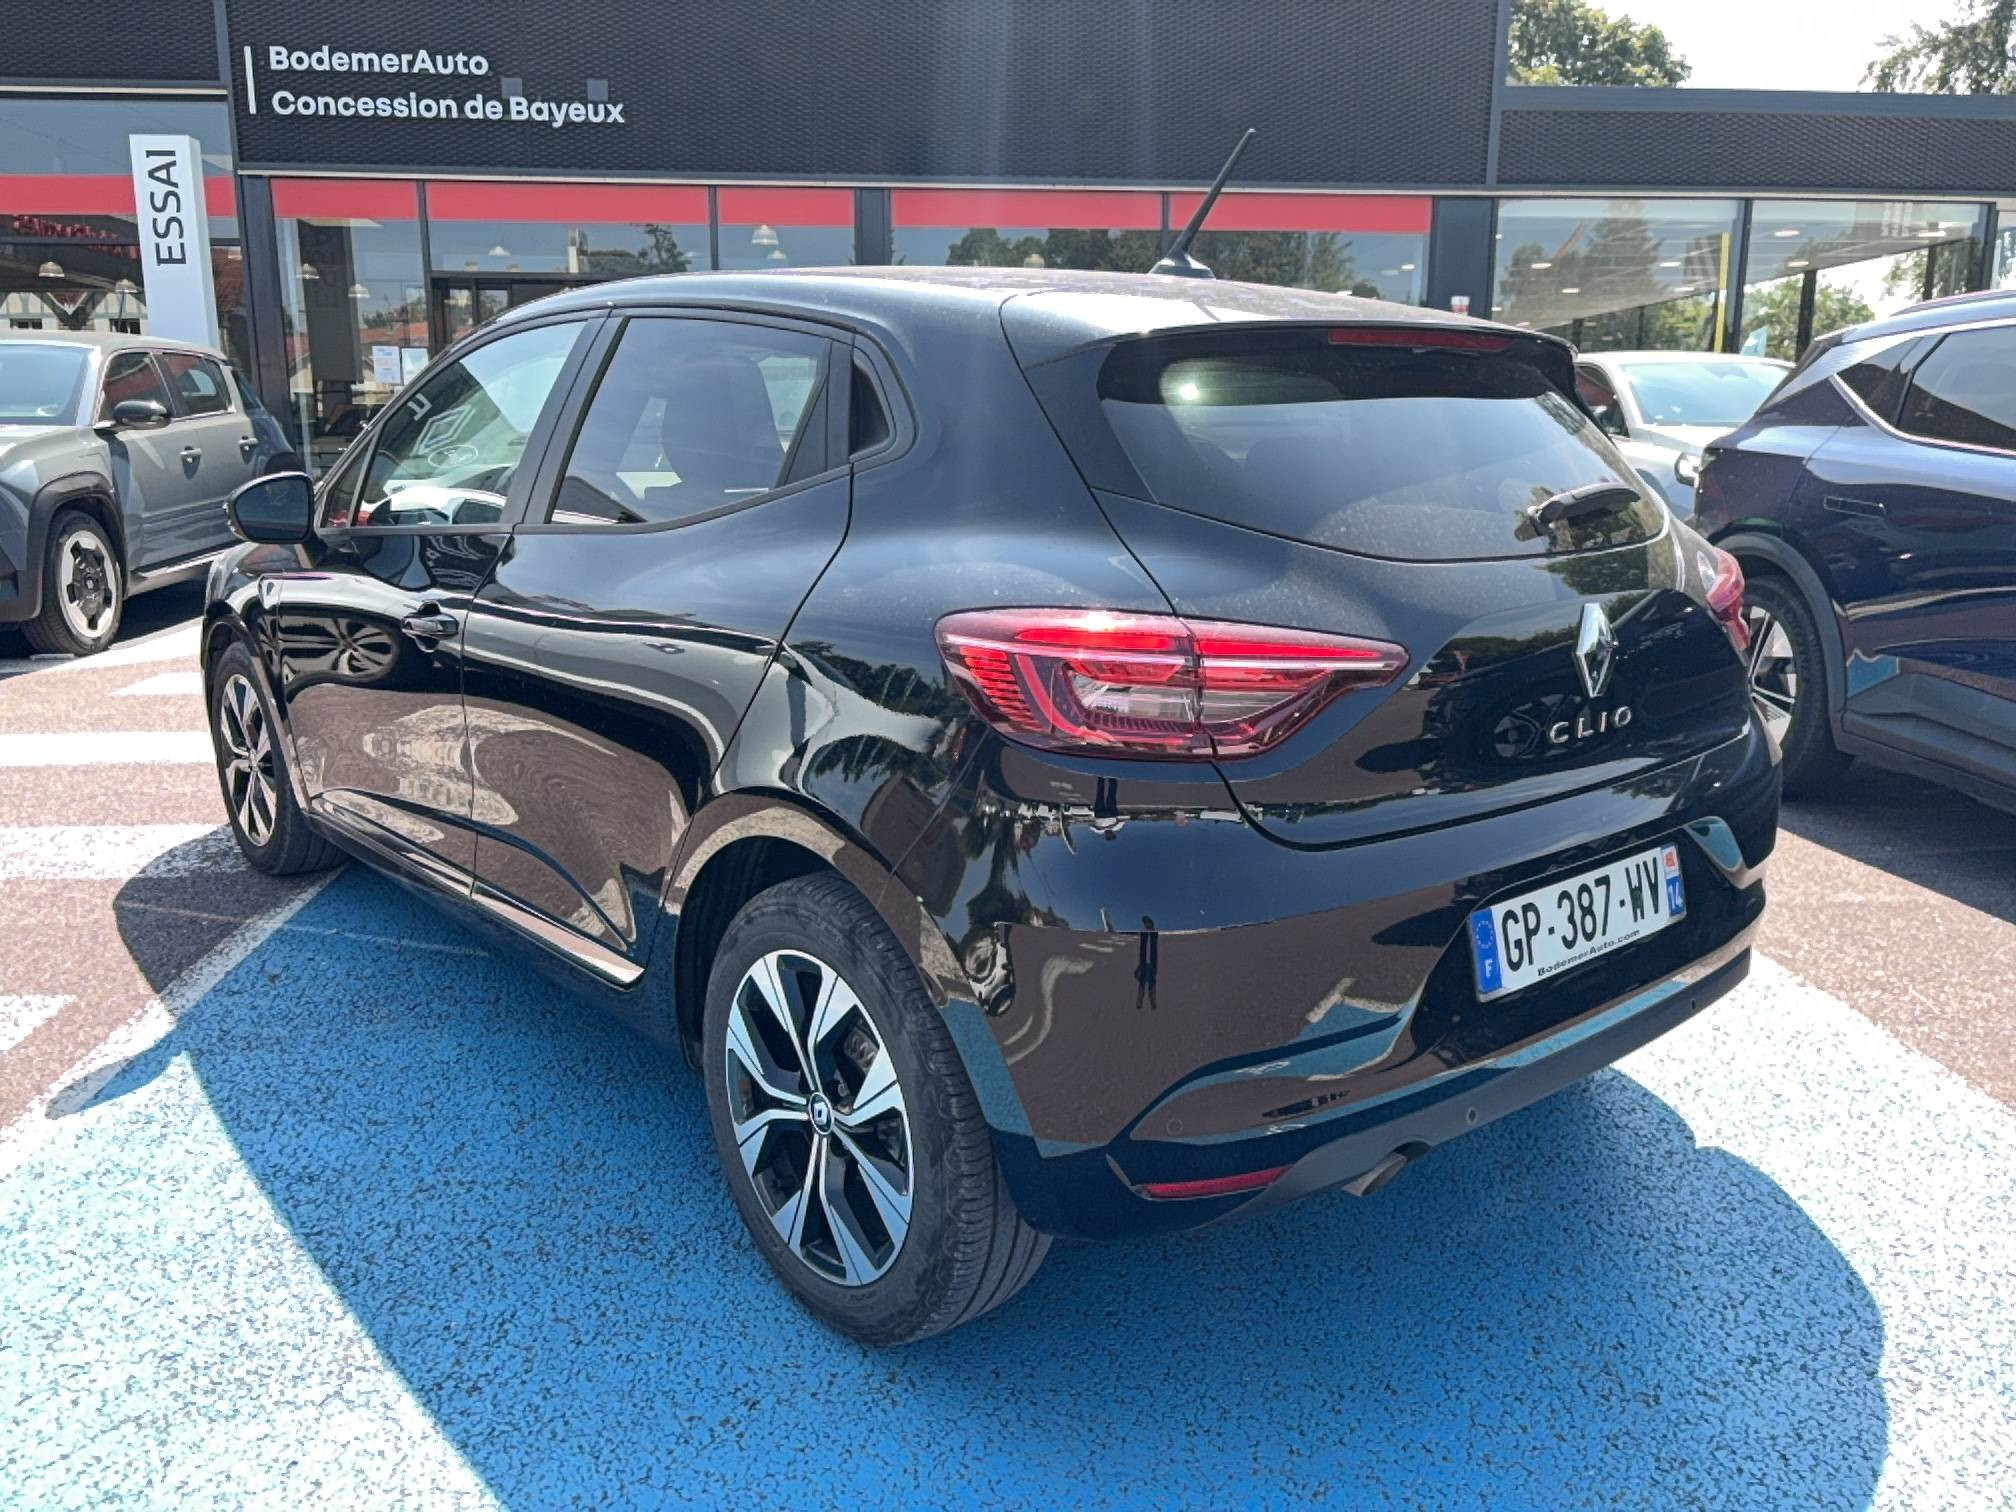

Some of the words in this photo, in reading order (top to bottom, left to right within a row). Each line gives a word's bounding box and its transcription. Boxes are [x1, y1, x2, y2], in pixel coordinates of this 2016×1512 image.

[269, 45, 489, 76] BodemerAuto
[271, 90, 459, 119] Concession
[464, 93, 503, 120] de
[509, 96, 625, 128] Bayeux
[145, 149, 187, 266] ESSAI
[1550, 705, 1632, 744] CLIO
[1483, 957, 1494, 979] F
[1667, 881, 1684, 912] 14
[1536, 929, 1641, 977] BodemerAuto.com
